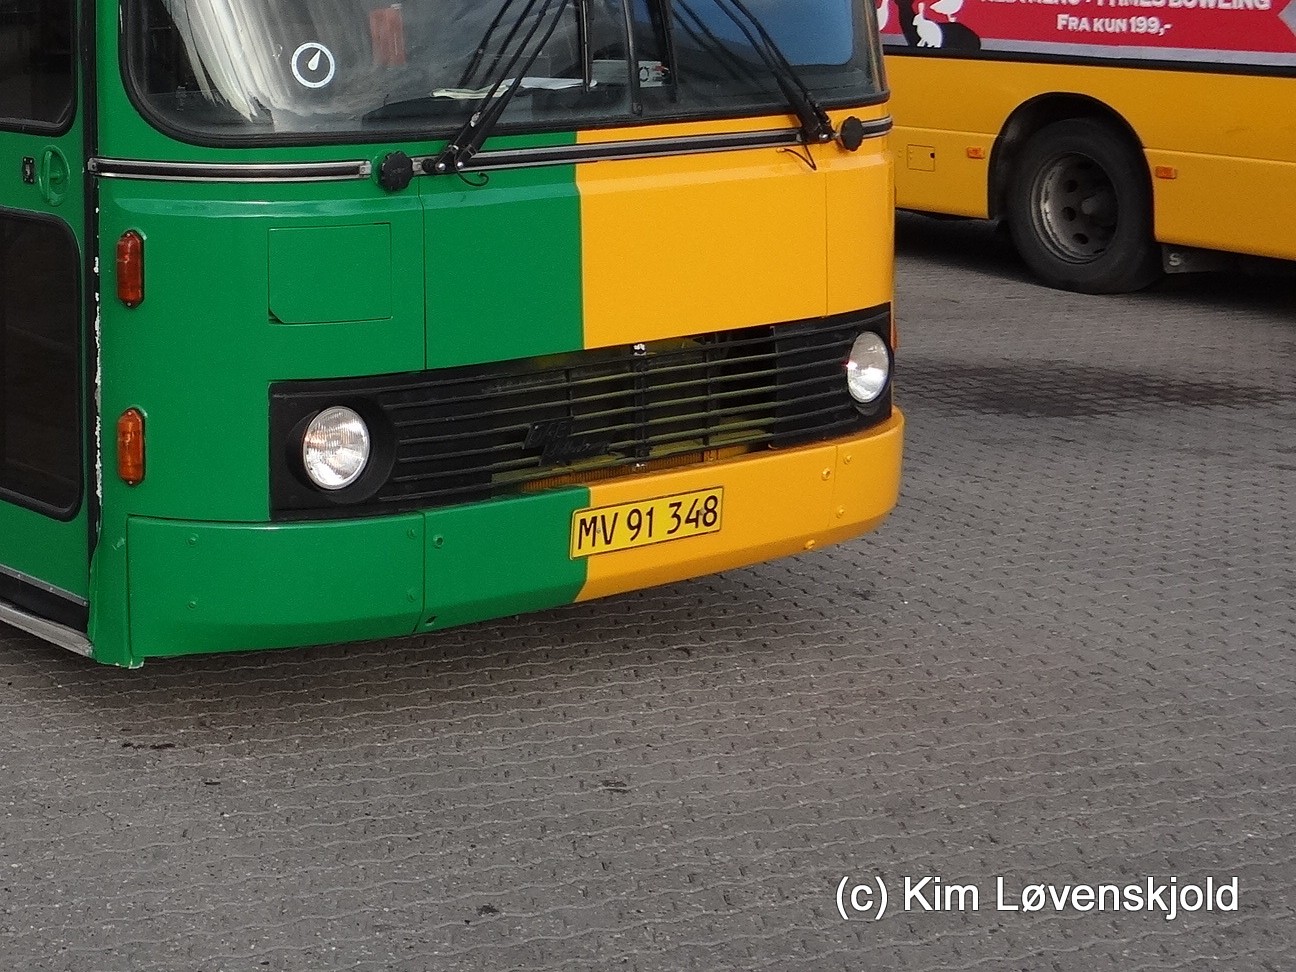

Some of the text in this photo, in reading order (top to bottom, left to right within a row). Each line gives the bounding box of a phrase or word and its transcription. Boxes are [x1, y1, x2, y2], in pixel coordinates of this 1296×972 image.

[1129, 15, 1173, 36] 199,-
[577, 495, 719, 550] MV 91 348
